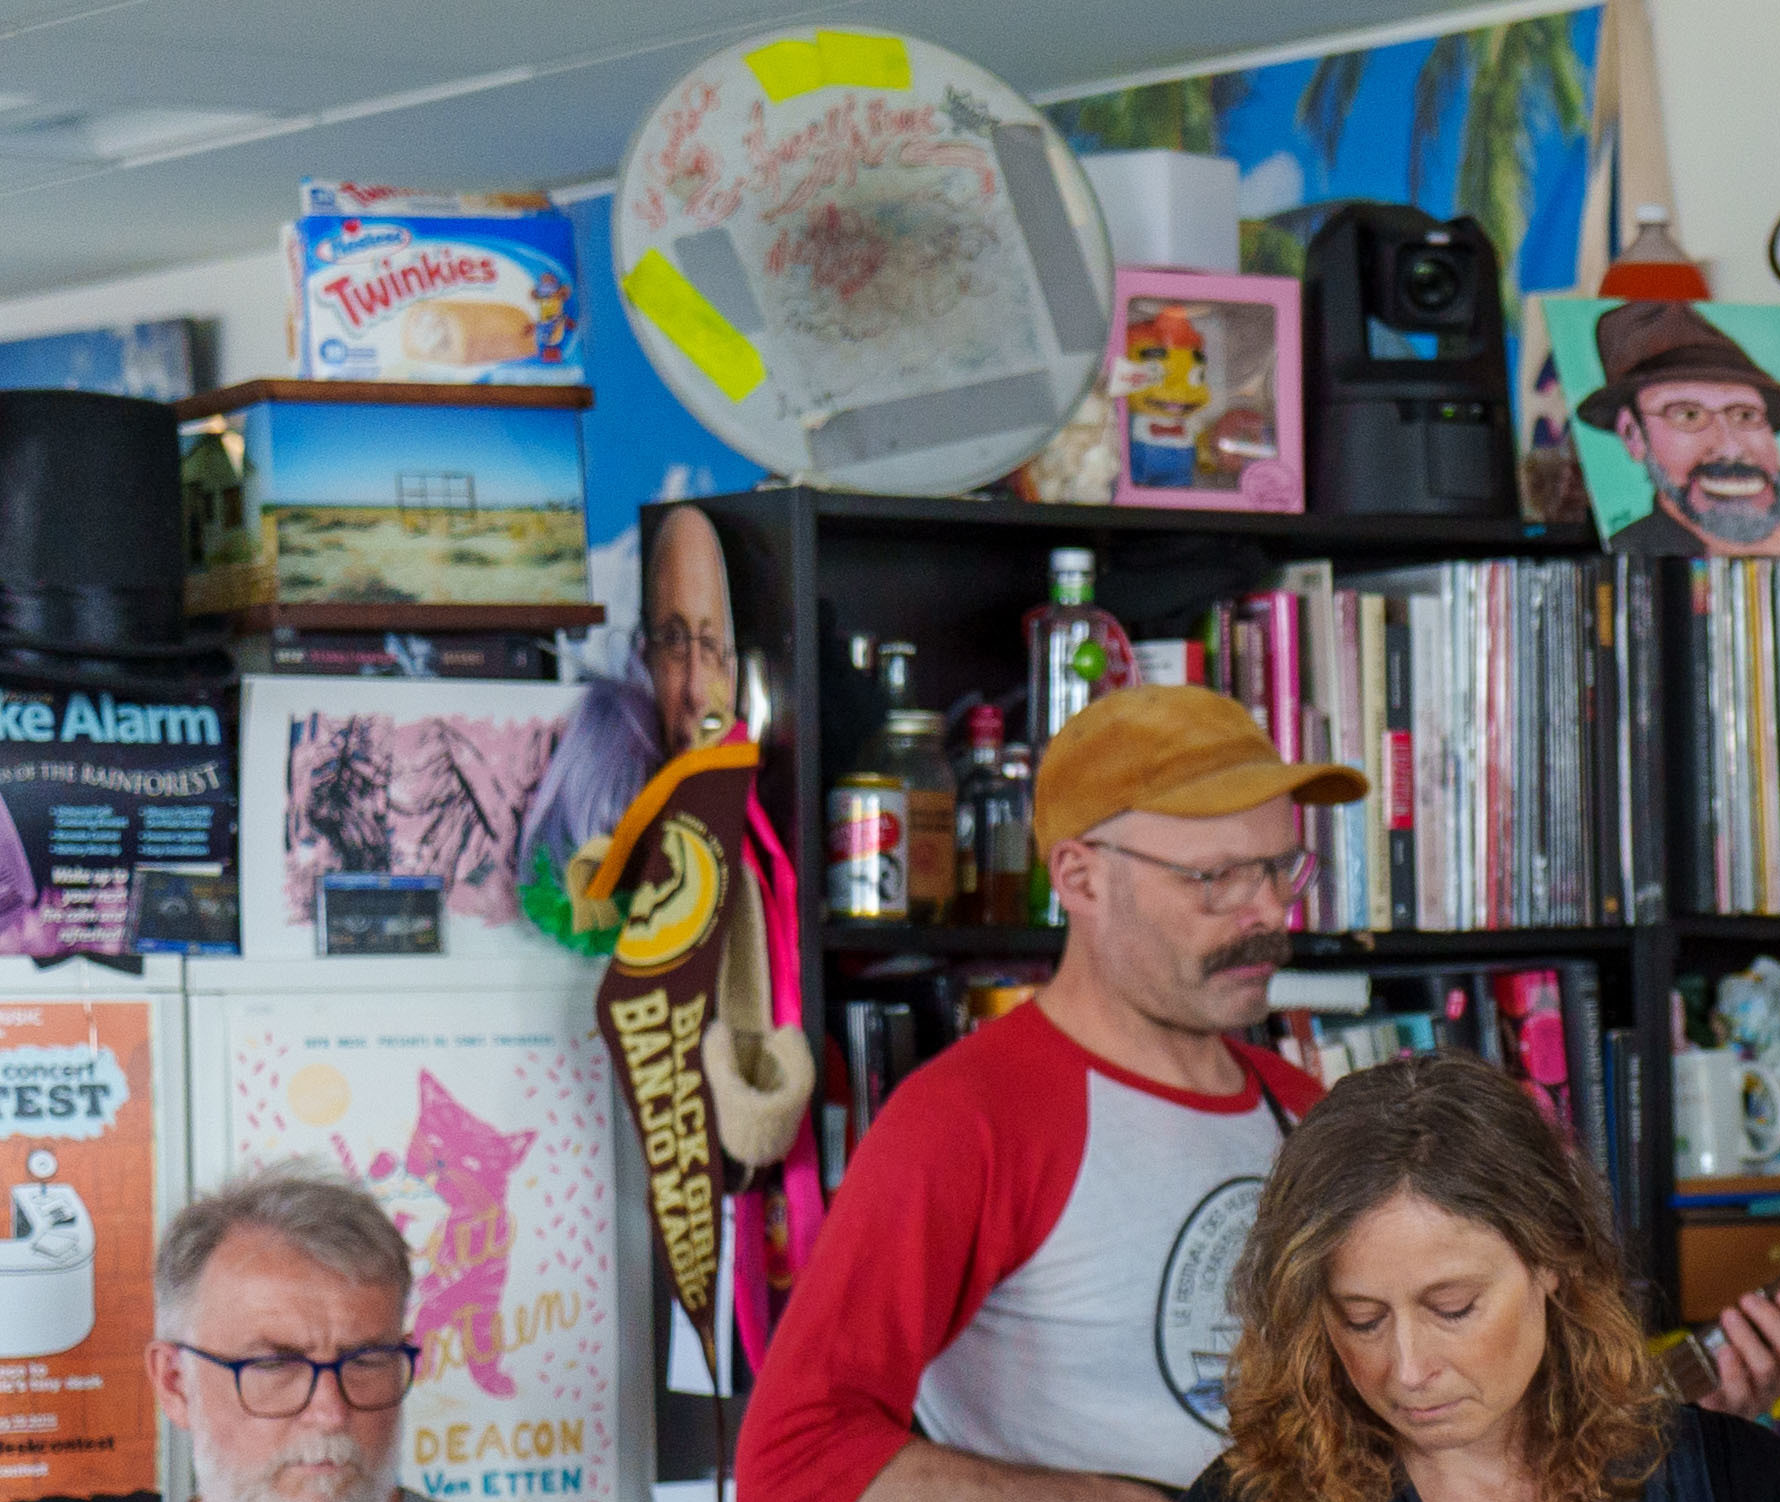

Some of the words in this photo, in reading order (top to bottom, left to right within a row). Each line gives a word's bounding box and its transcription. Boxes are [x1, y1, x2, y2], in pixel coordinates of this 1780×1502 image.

[323, 250, 497, 329] Twinkies
[59, 692, 222, 746] Alarm
[3, 1063, 95, 1081] concert
[672, 992, 711, 1174] BLACK
[609, 987, 678, 1167] BANJO
[651, 1167, 708, 1312] MAGIC
[683, 1173, 719, 1291] GIRL
[413, 1419, 585, 1465] DEACON
[482, 1466, 583, 1495] ETTEN
